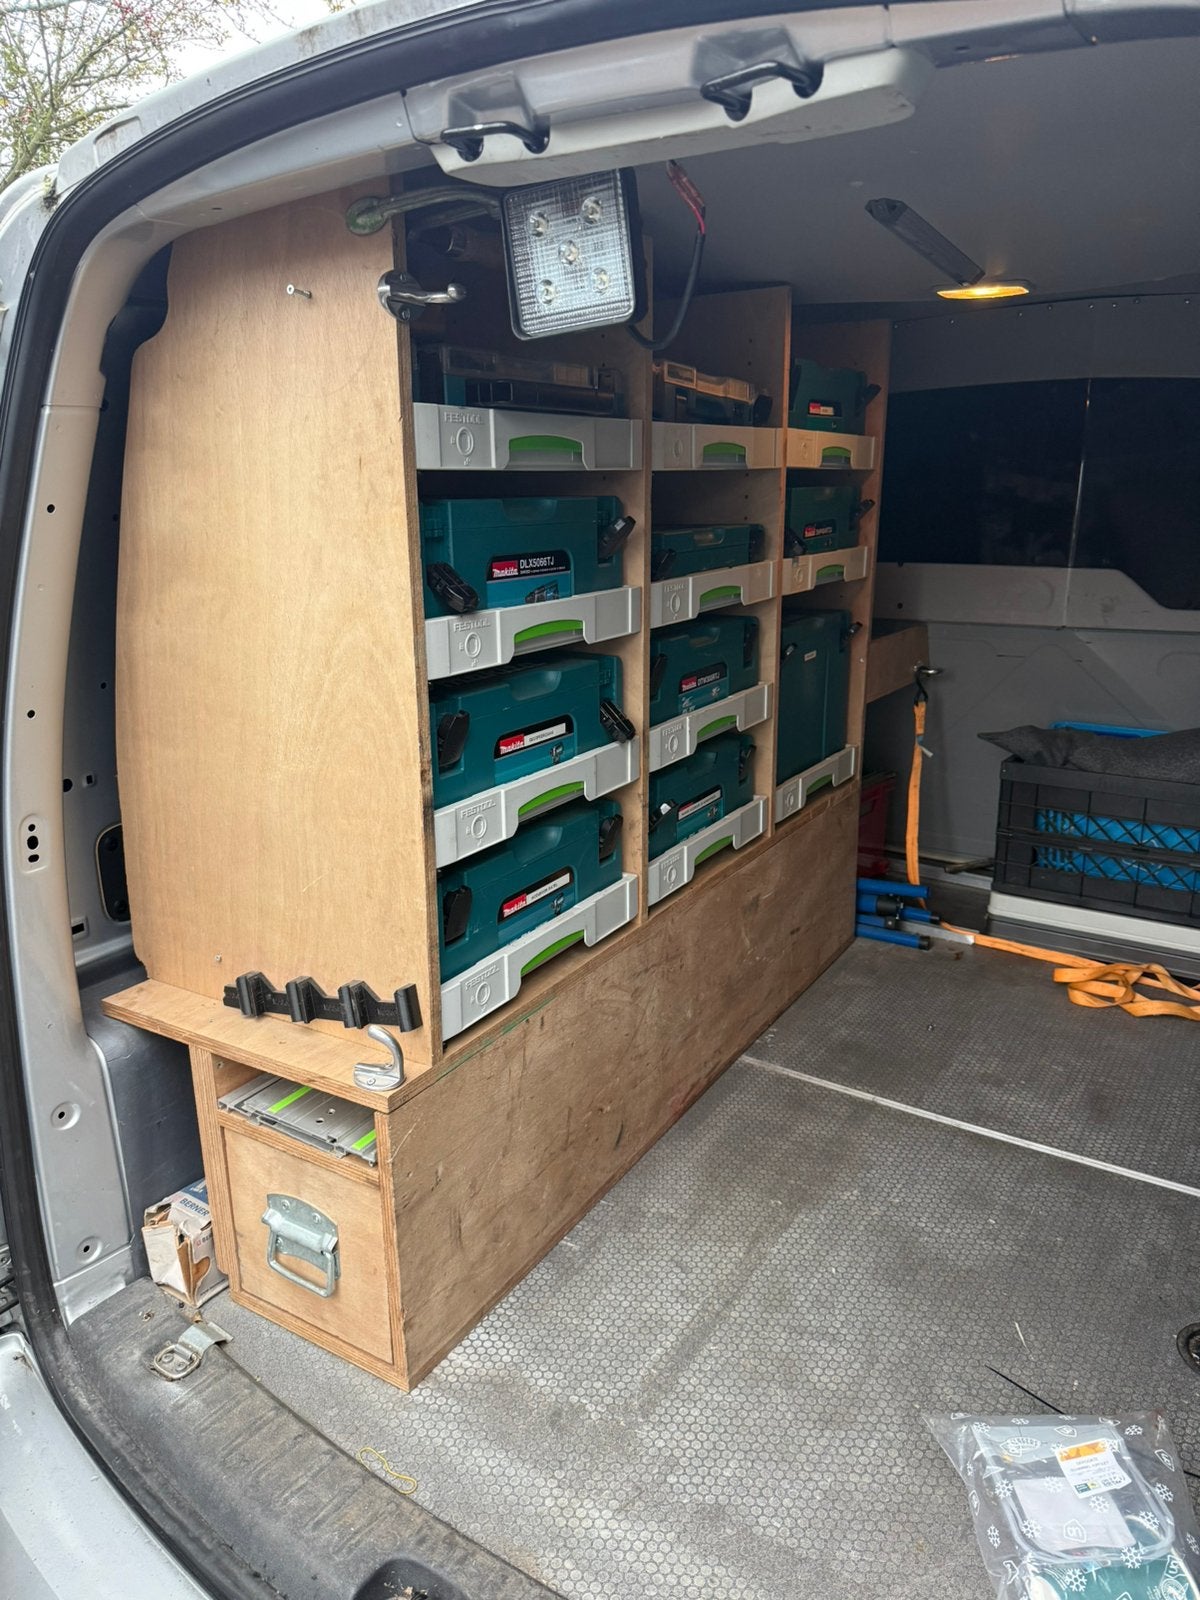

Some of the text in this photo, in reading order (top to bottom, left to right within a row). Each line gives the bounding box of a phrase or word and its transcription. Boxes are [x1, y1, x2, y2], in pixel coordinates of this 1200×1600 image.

[460, 799, 497, 820] FESTOOL
[464, 964, 500, 991] FESTOOL
[179, 1197, 210, 1217] BERNER
